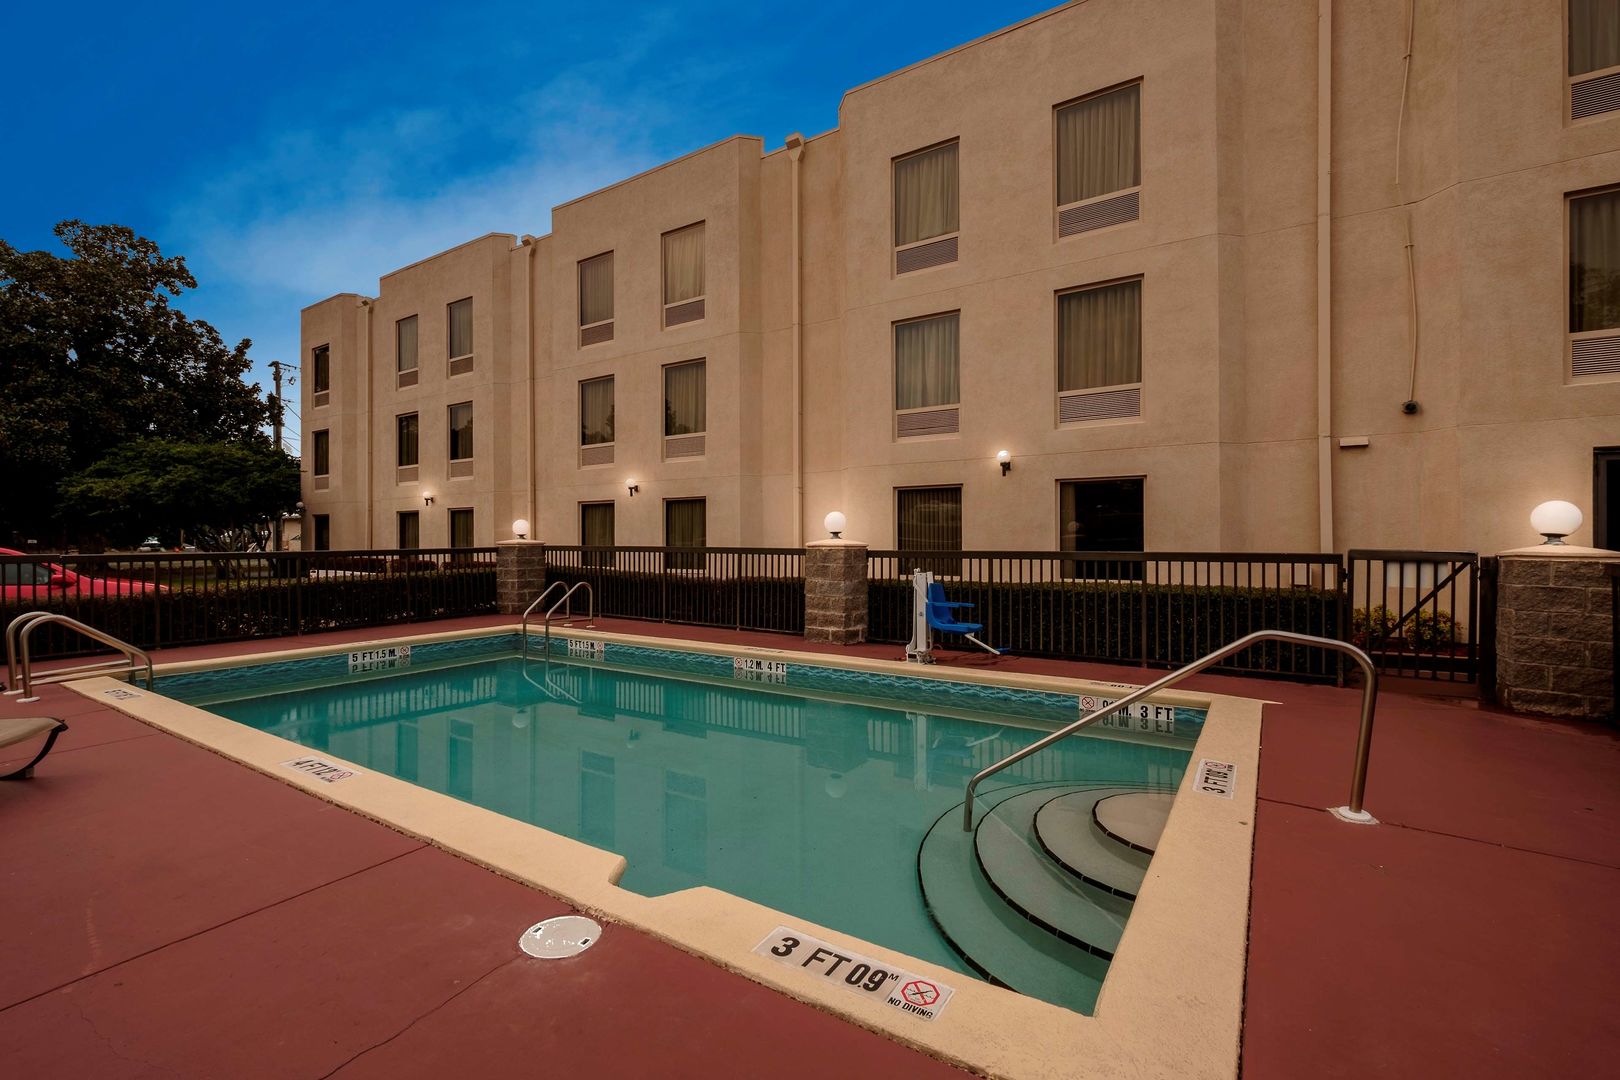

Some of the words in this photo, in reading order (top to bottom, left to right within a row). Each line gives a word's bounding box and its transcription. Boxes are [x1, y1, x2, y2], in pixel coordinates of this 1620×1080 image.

[570, 640, 574, 648] 5
[352, 653, 358, 662] 5
[376, 650, 387, 659] 1.5
[745, 659, 754, 669] 1.2
[767, 662, 773, 671] 4
[1140, 706, 1148, 719] 3
[1155, 707, 1172, 720] FT.
[1204, 776, 1228, 788] FT
[1202, 786, 1226, 794] 3
[770, 937, 801, 957] 3
[801, 948, 852, 977] FT
[887, 997, 901, 1007] NO
[902, 1003, 933, 1019] DIVING
